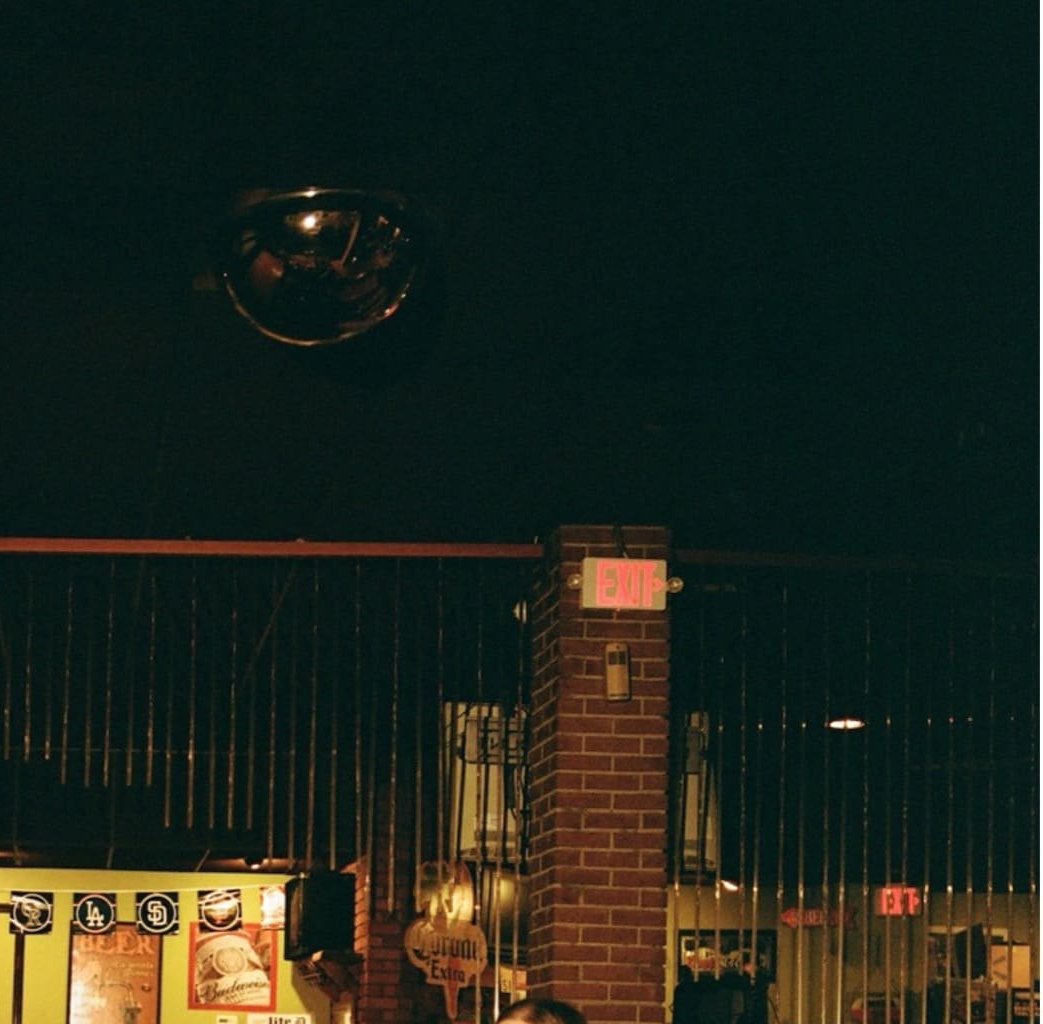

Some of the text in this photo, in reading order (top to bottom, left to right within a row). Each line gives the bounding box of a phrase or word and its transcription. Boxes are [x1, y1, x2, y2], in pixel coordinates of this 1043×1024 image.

[597, 560, 655, 608] EXIT
[86, 901, 104, 926] LA
[147, 901, 167, 926] SD
[880, 887, 917, 915] EXT
[430, 959, 466, 983] Extra
